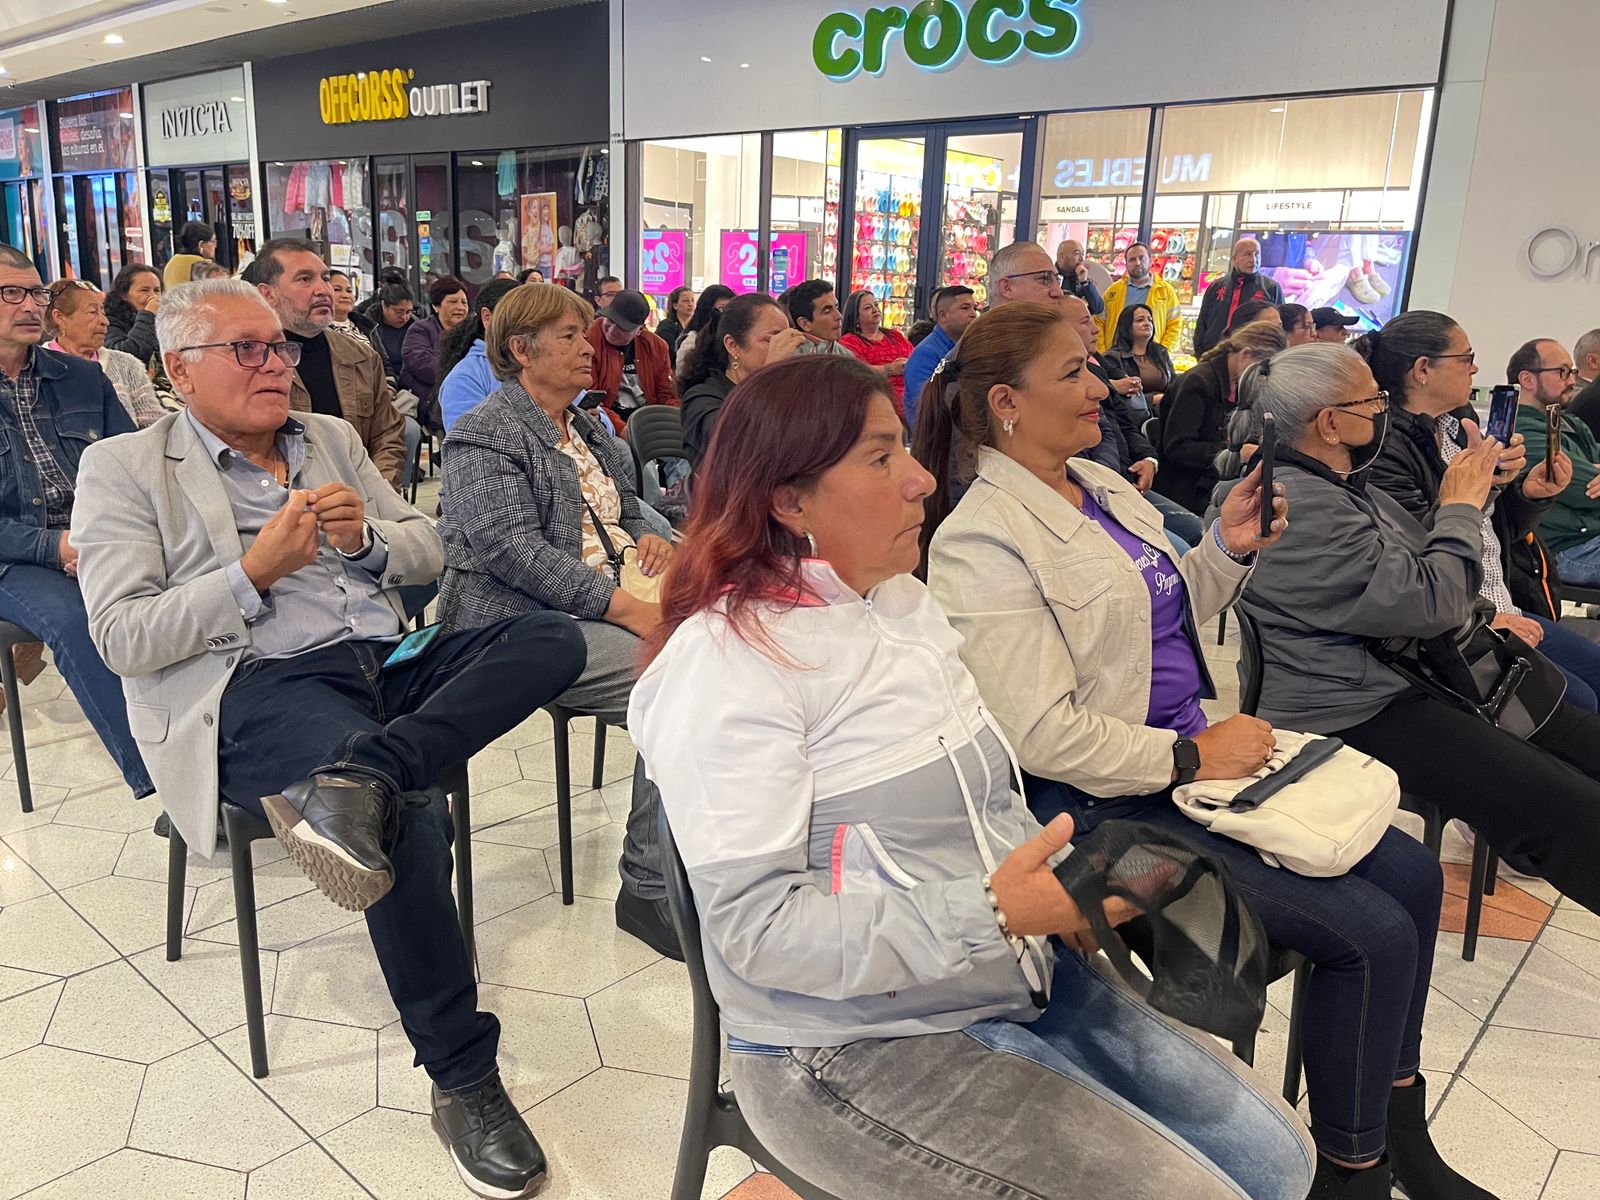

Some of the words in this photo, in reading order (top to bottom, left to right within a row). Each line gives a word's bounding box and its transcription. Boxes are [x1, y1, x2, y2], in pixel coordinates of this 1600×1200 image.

[812, 0, 1079, 77] crocs
[161, 100, 233, 139] INVICTA
[319, 67, 409, 125] OFFCORSS
[409, 79, 492, 117] OUTLET
[1266, 201, 1312, 210] LIFESTYLE
